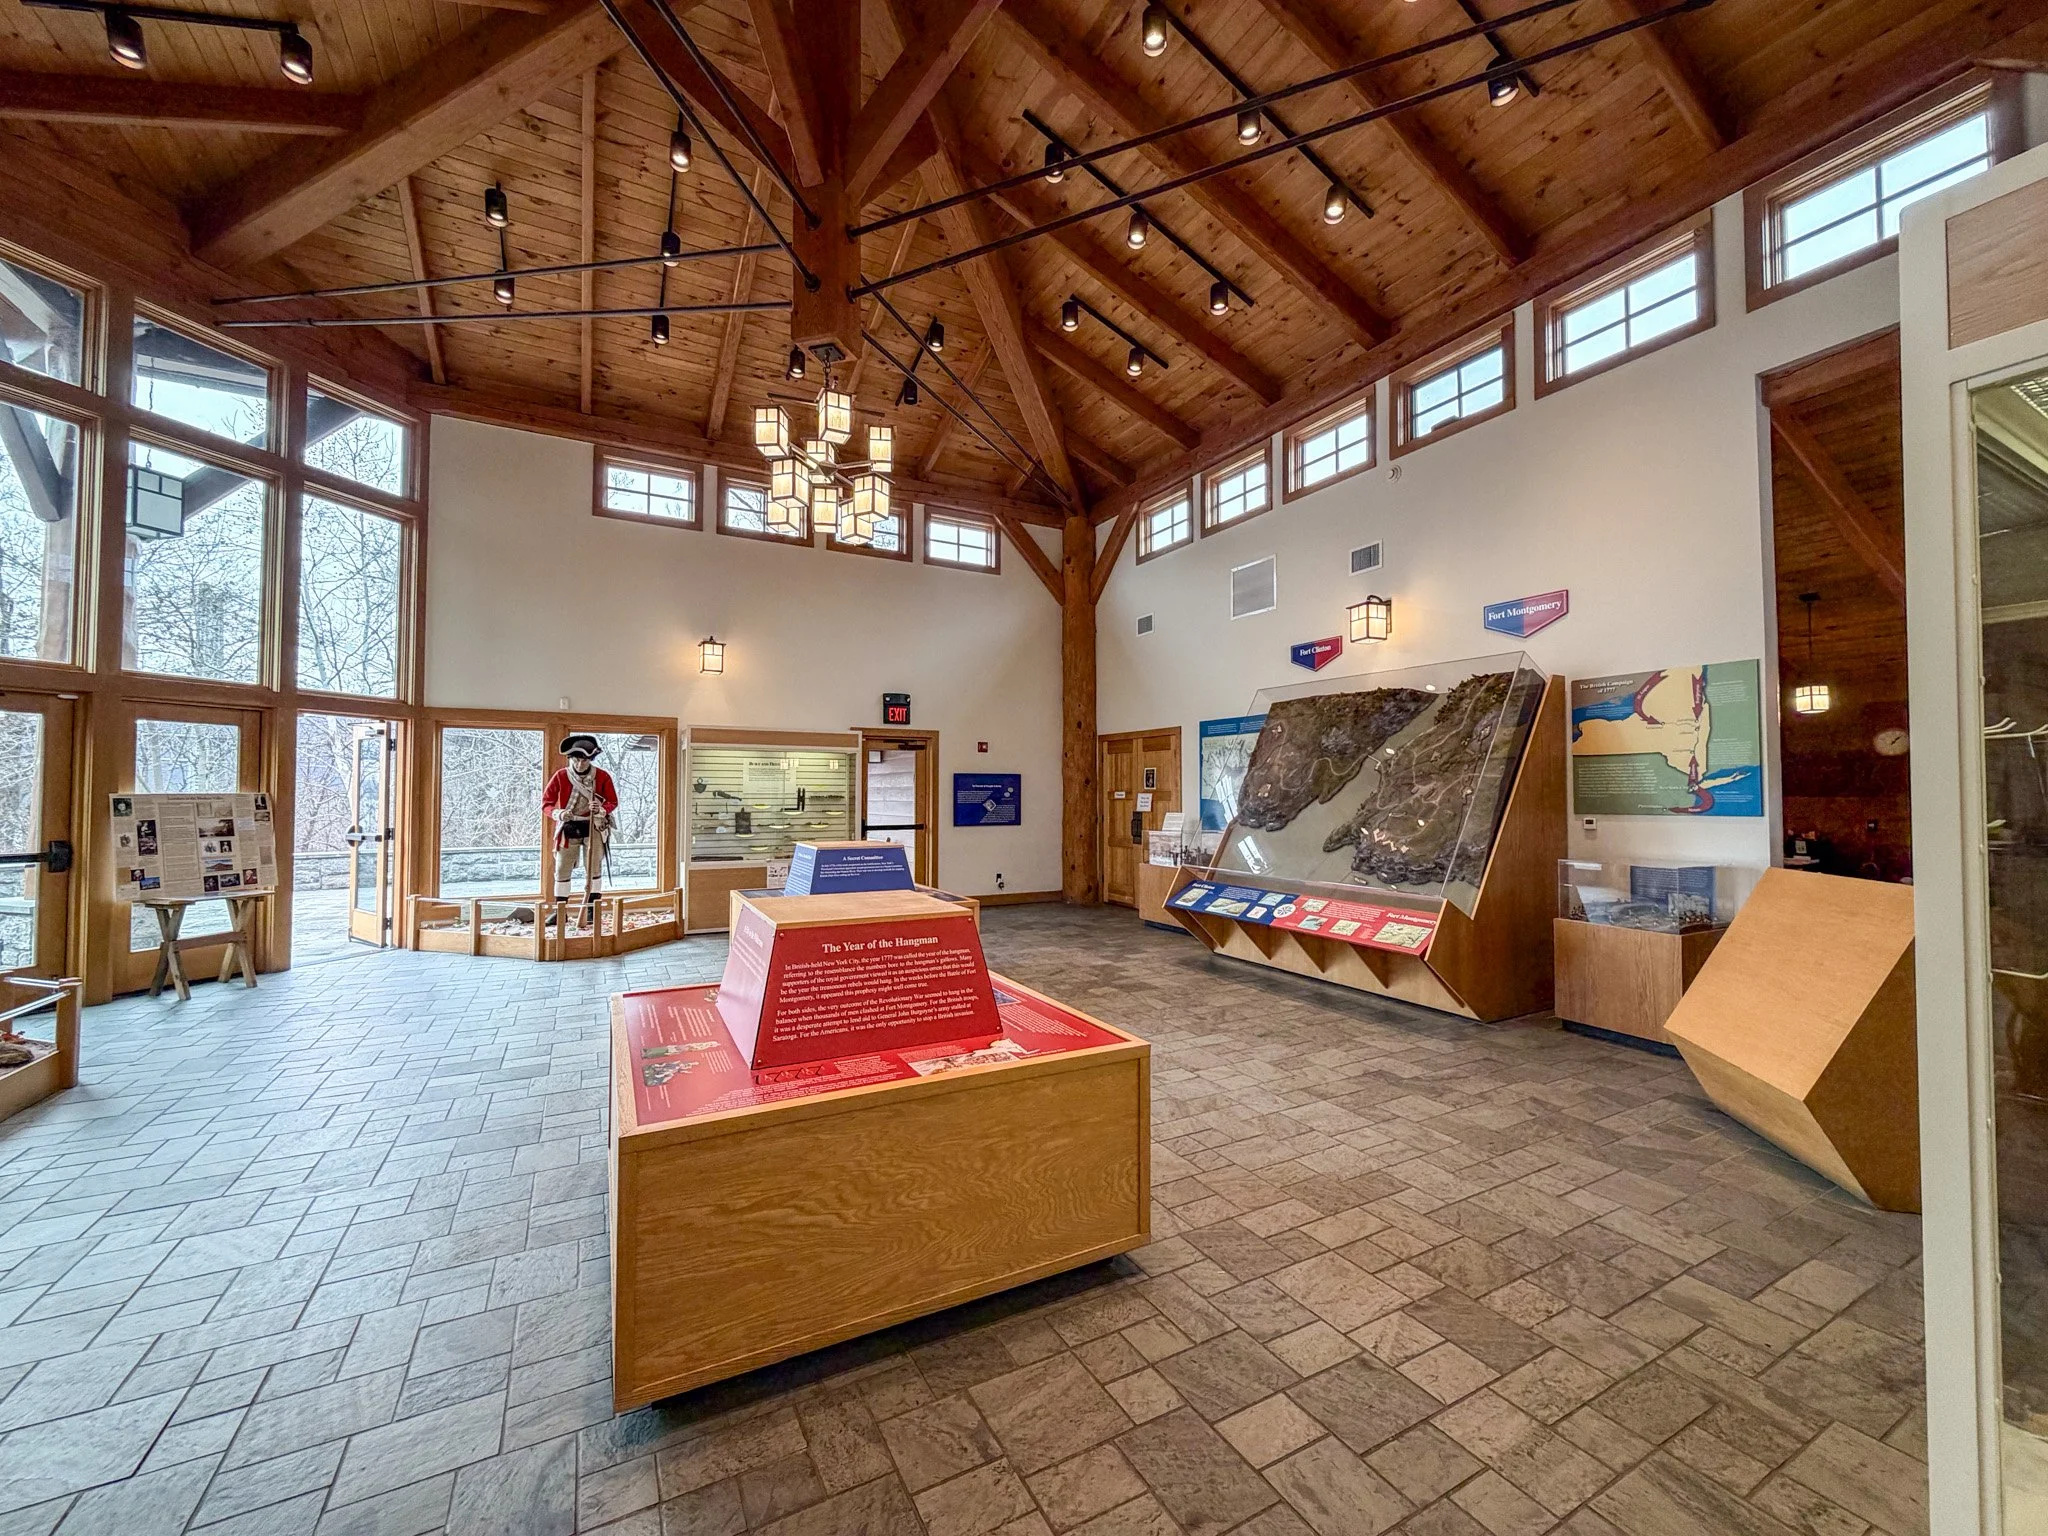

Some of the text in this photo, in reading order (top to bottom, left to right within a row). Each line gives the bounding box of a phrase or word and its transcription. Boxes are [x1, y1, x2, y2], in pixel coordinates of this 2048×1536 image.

[1488, 600, 1562, 621] Fort Montgomery
[1300, 644, 1332, 656] Fort Clinton
[888, 708, 907, 722] EXIT
[822, 938, 938, 953] The Year of the Hangman
[782, 980, 810, 988] supporters
[840, 973, 869, 982] government
[821, 991, 844, 1000] appeared
[797, 1022, 822, 1031] desperate
[888, 1018, 916, 1027] opportunity
